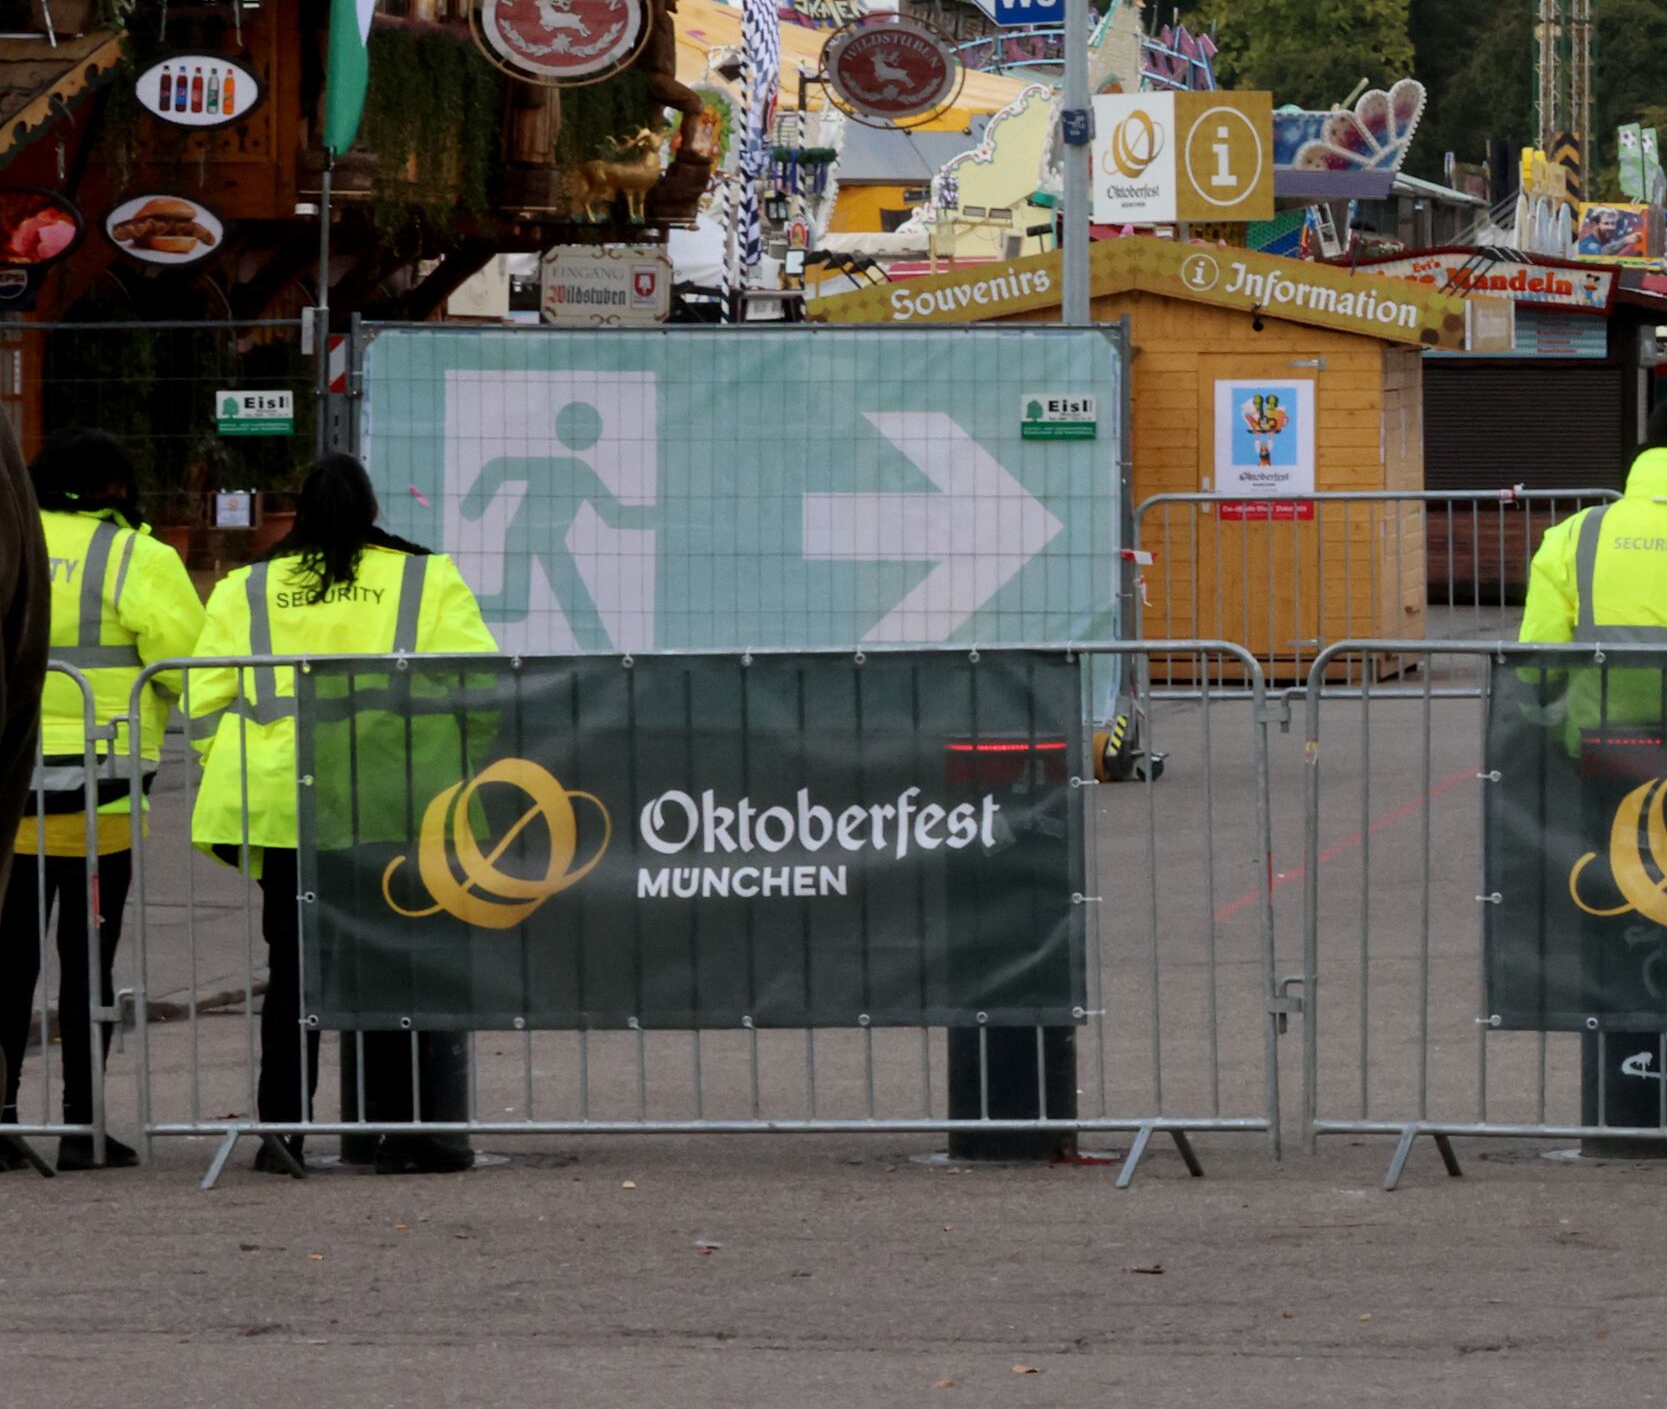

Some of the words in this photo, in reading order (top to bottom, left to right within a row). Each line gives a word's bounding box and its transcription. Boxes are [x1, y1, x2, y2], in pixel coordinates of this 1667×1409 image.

[843, 32, 943, 70] WILDSTUBEN
[1107, 184, 1160, 200] Oktoberfest
[551, 267, 624, 280] EINGANG
[1412, 258, 1441, 274] Evi's
[550, 284, 626, 306] Wildstuben
[890, 267, 1051, 320] Souvenirs
[1225, 261, 1418, 328] Information
[244, 396, 284, 409] Eisl
[1048, 399, 1088, 412] Eisl
[275, 584, 386, 611] SECURITY
[640, 787, 999, 860] Oktoberfest
[637, 864, 848, 899] MÜNCHEN
